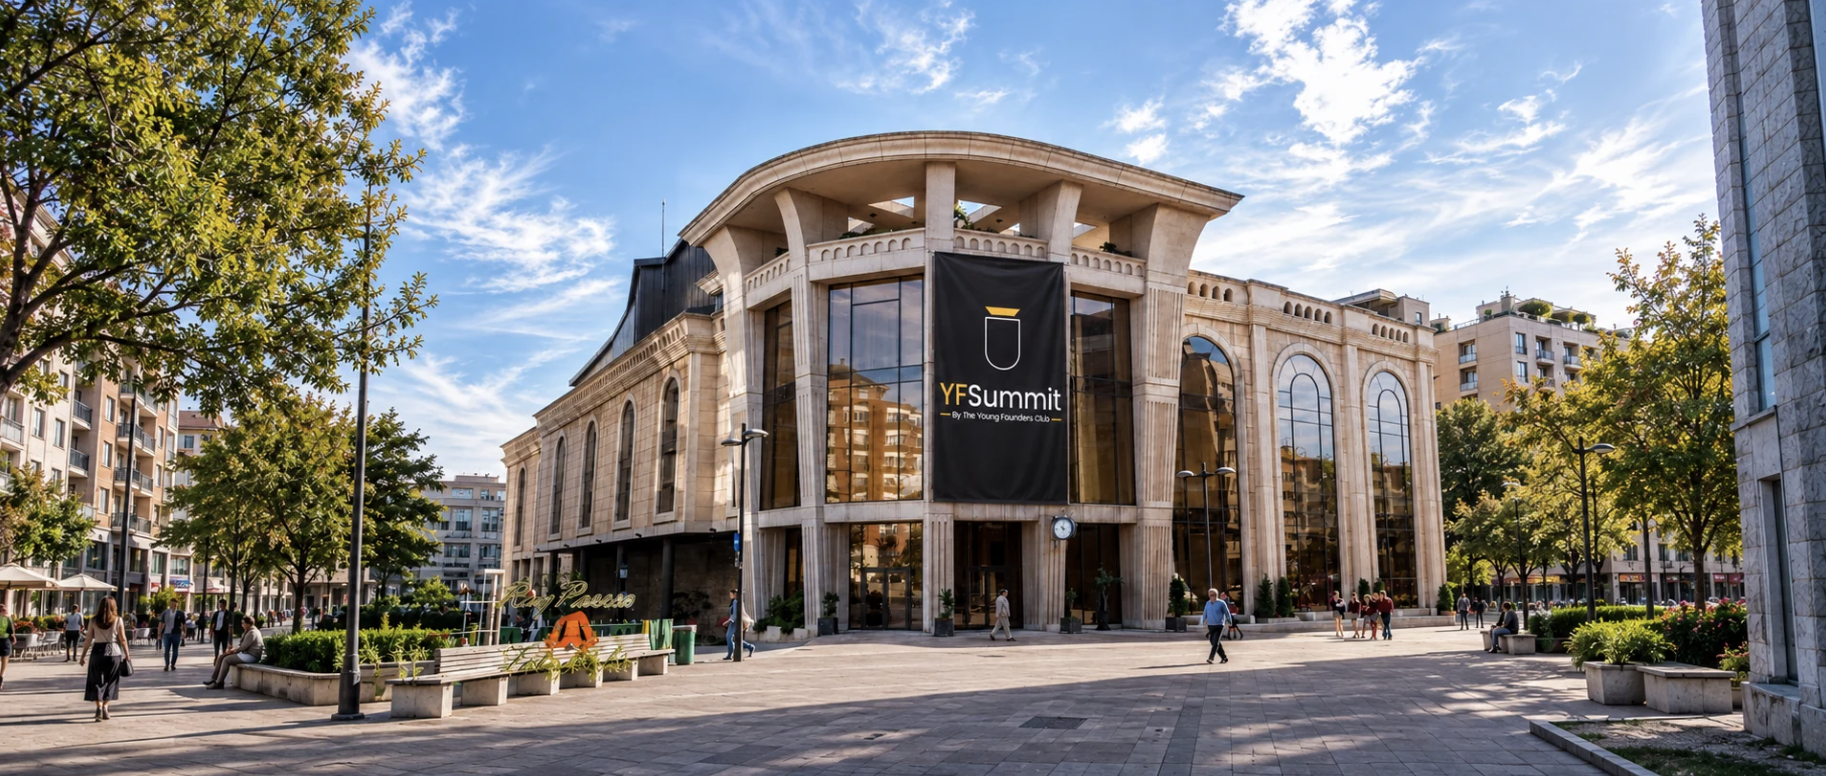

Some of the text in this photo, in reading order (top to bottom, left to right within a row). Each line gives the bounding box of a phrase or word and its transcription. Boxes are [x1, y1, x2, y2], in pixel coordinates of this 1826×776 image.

[940, 382, 1062, 411] YFSummit
[952, 411, 1050, 423] By The Young Founders Club
